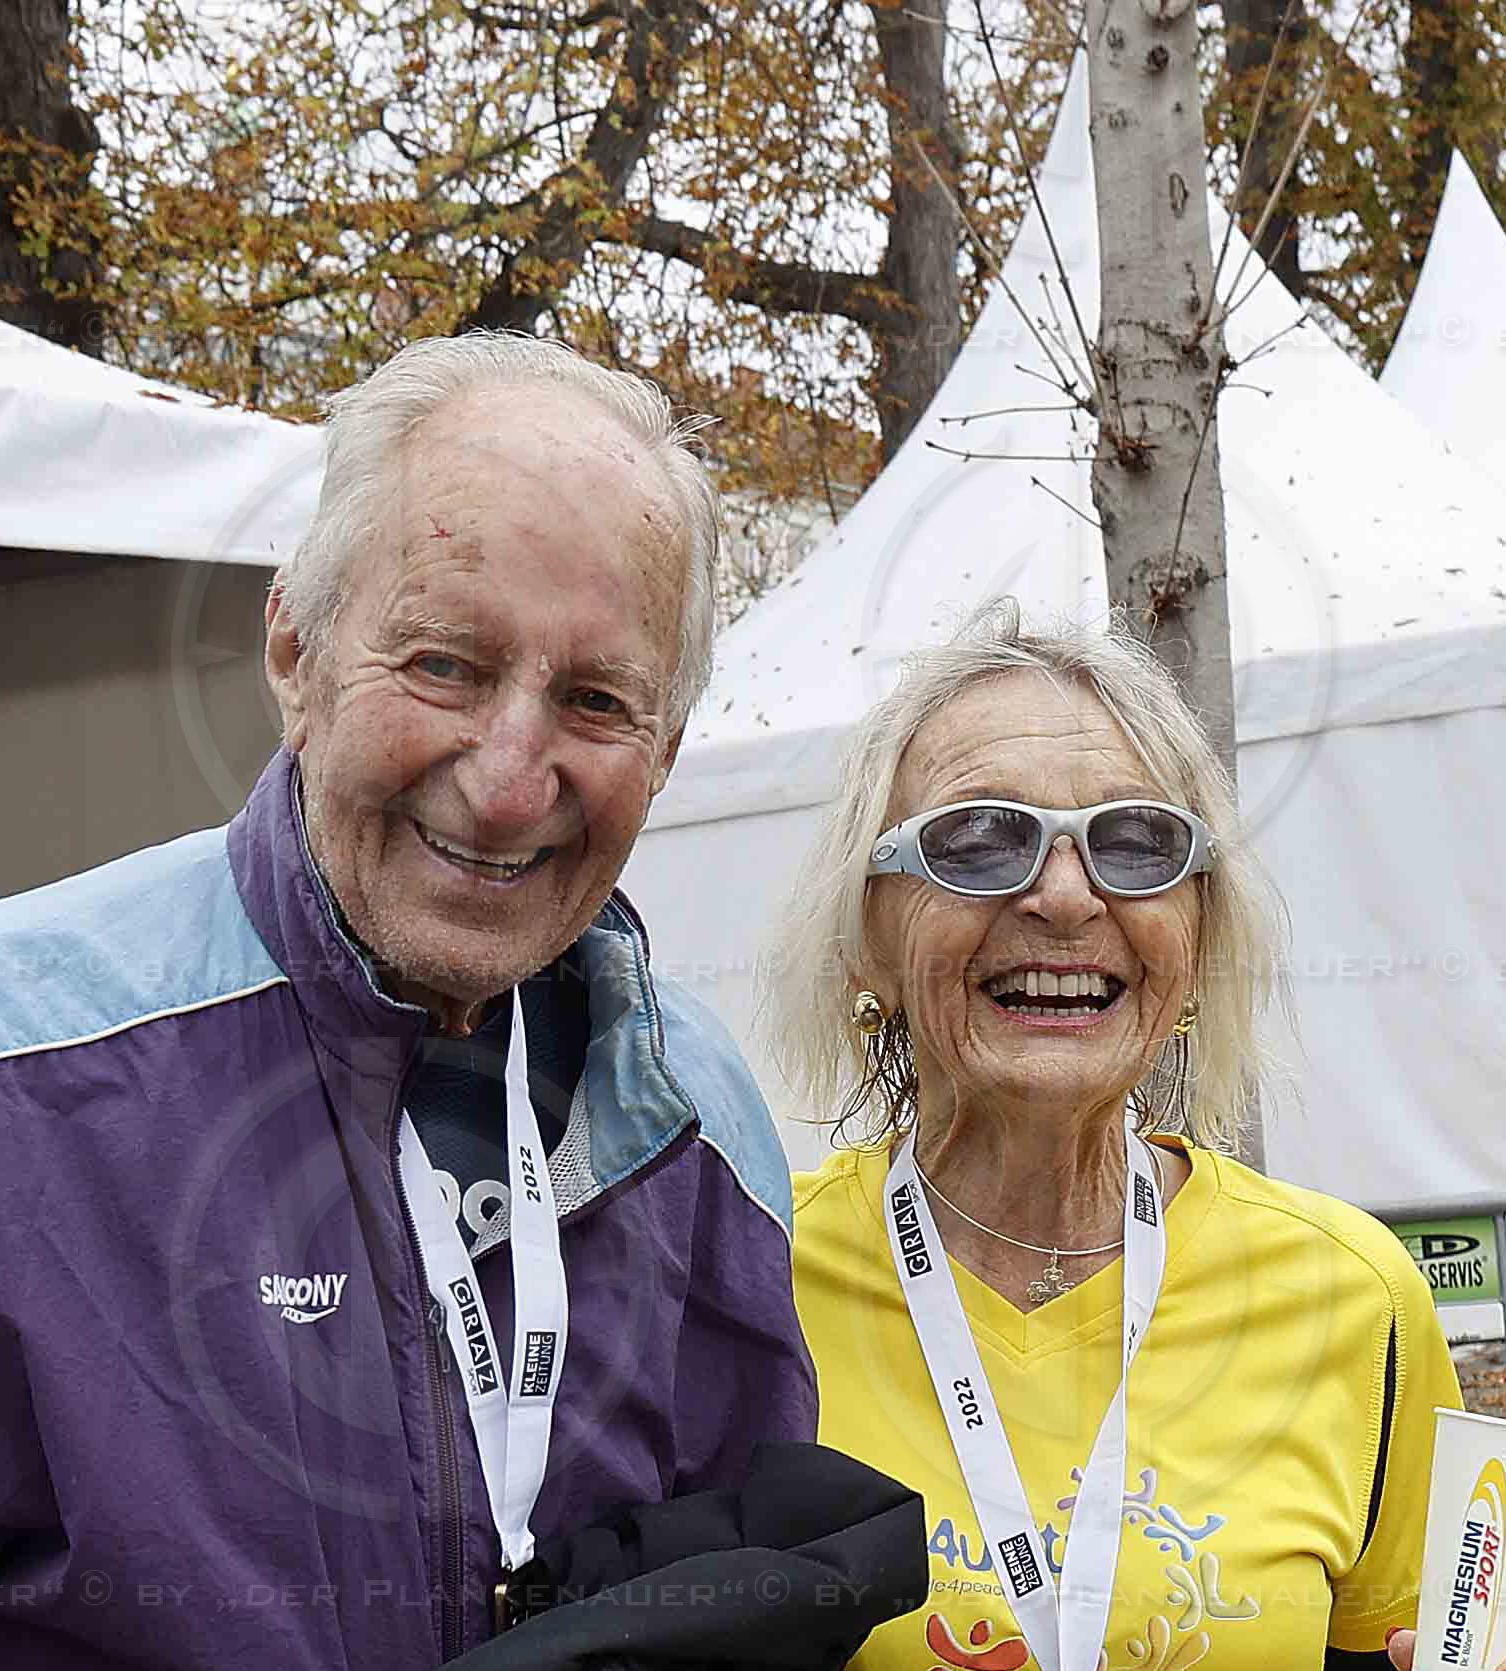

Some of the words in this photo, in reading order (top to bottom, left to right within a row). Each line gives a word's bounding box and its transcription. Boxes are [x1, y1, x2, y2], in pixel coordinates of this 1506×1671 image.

[520, 1145, 542, 1205] 2022
[894, 1186, 930, 1276] GRAZ
[1429, 1258, 1484, 1289] SERVIS
[450, 1279, 498, 1392] GRAZ
[522, 1333, 542, 1395] KLEINE
[535, 1333, 554, 1394] ZEITUNG
[953, 1376, 985, 1431] 2022
[1000, 1542, 1029, 1596] KLEINE
[1013, 1535, 1041, 1589] ZEITUNG
[1441, 1520, 1484, 1665] MAGNESIUM
[1473, 1526, 1501, 1609] SPORT
